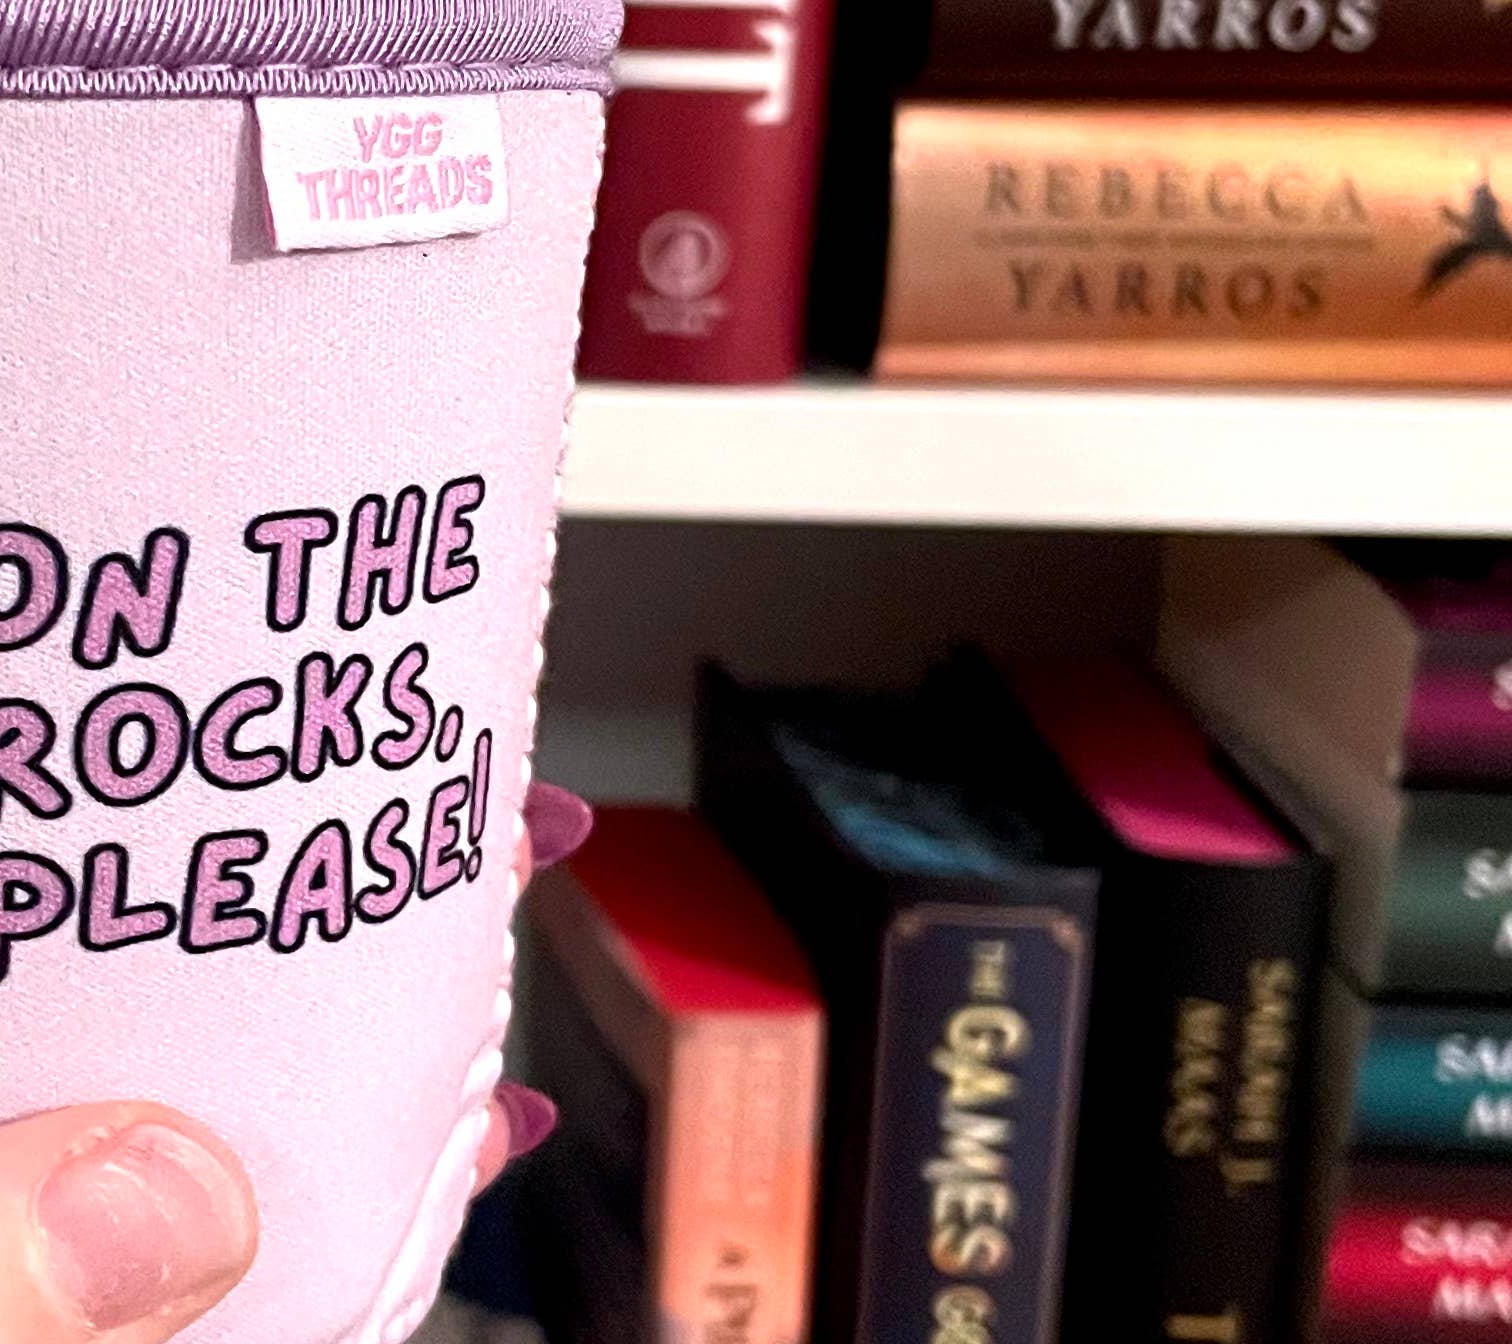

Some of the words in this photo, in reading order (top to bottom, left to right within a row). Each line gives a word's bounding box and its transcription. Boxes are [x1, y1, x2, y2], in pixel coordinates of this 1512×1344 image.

[295, 153, 494, 221] THREADS
[984, 160, 1369, 224] REBECCA
[1007, 257, 1328, 320] YARROS
[243, 473, 486, 632] THE
[922, 1003, 1034, 1277] GAMES
